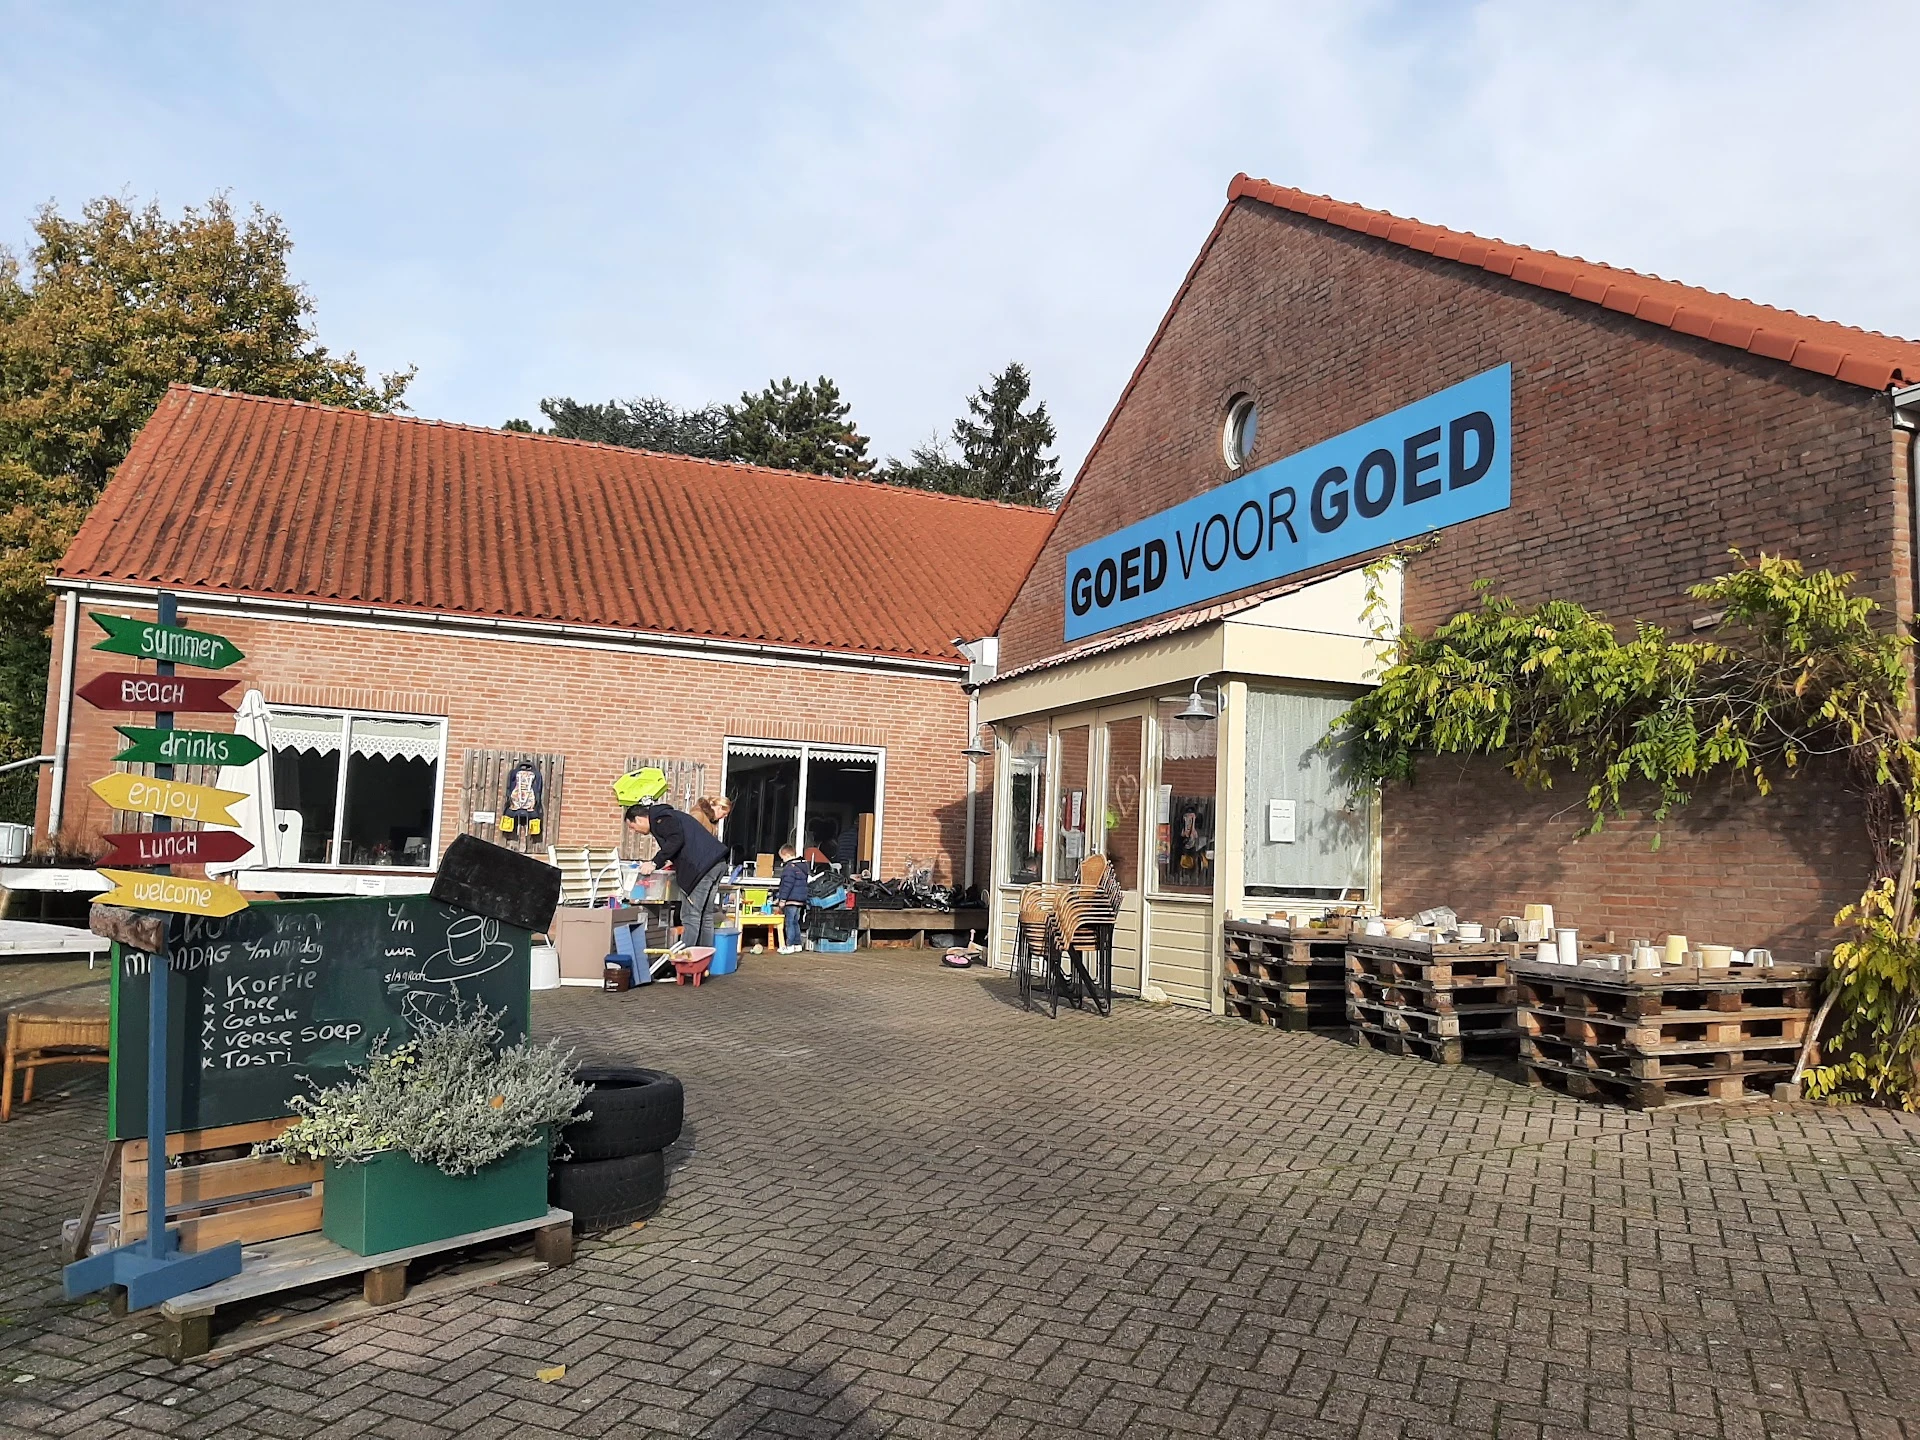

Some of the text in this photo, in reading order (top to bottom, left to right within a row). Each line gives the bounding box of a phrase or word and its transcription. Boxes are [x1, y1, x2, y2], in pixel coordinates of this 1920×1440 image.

[1071, 410, 1495, 617] GOED VOOR GOED
[140, 627, 224, 661] Summer
[160, 732, 229, 760] drinks
[128, 782, 199, 818] enjoy
[133, 881, 212, 908] welcome
[223, 1008, 298, 1030] Gebak
